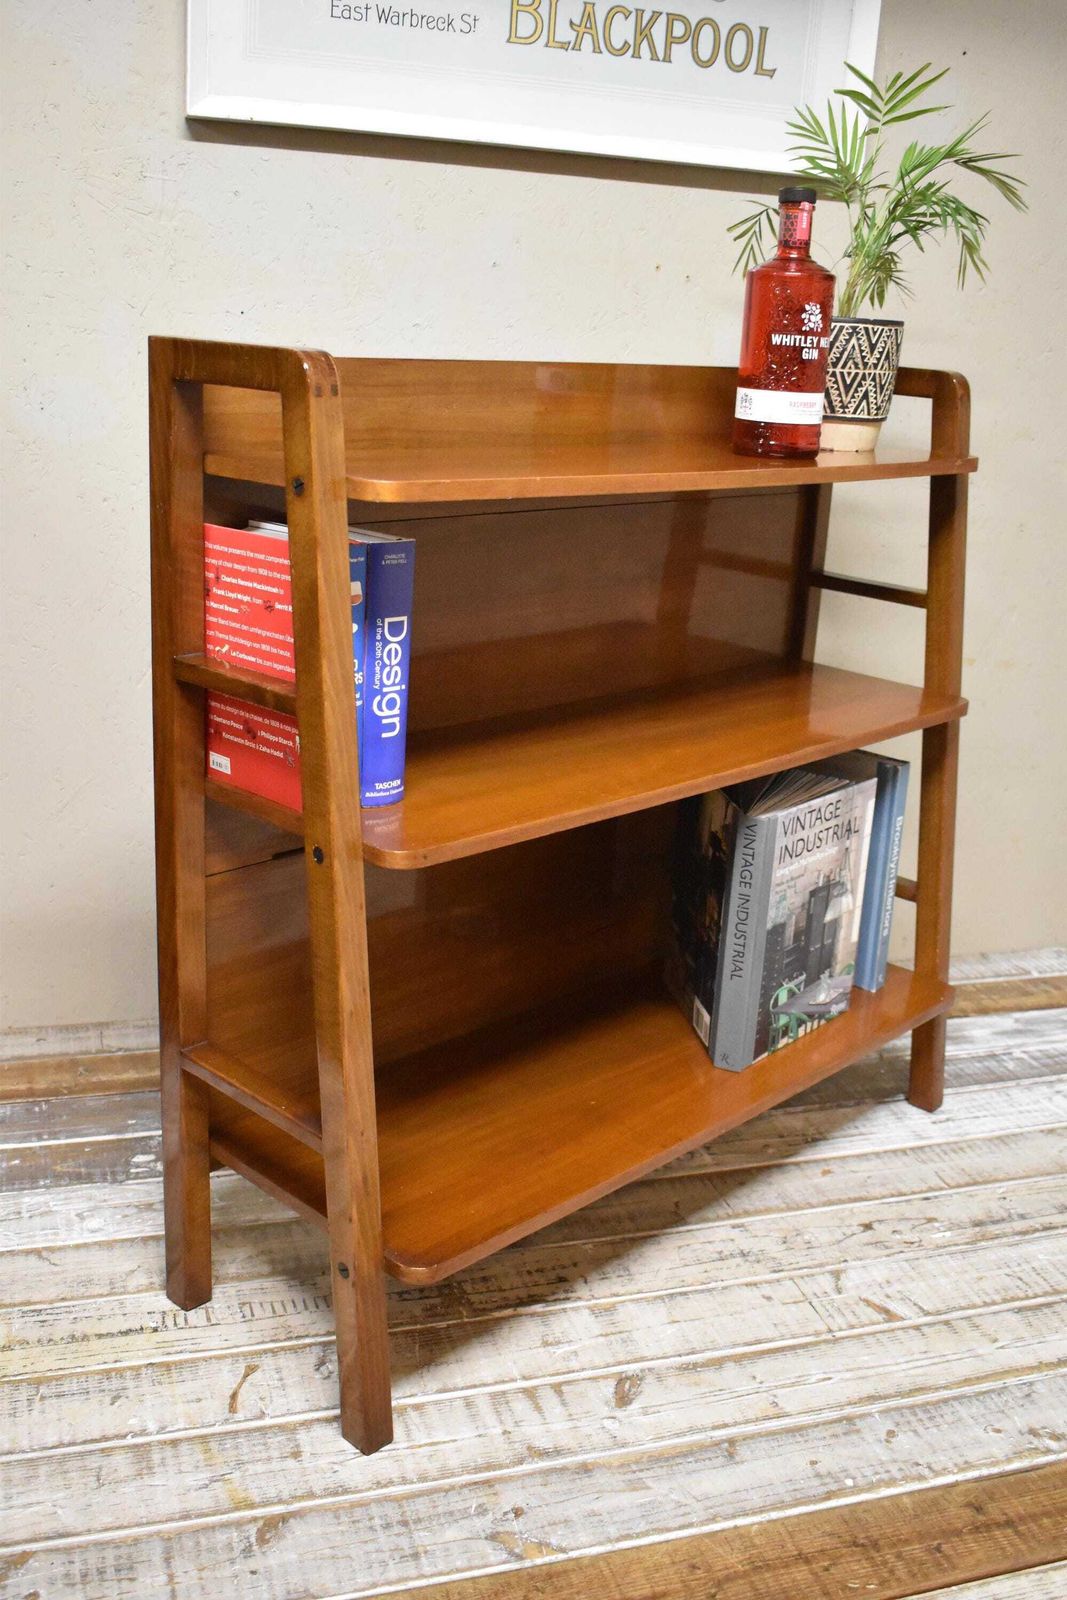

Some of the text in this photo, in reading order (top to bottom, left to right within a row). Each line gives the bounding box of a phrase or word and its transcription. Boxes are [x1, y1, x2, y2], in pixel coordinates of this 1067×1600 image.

[330, 0, 480, 35] East Warbreck St
[507, 0, 777, 79] BLACKPOOL
[771, 333, 818, 348] WHITLEY
[802, 348, 819, 361] GIN
[373, 618, 383, 690] of the 20th Century
[373, 616, 408, 738] Design
[374, 779, 401, 790] TASCHEN
[778, 817, 860, 865] INDUSTRIAL
[782, 799, 842, 838] VINTAGE
[882, 815, 903, 937] Brooklyn Interiors
[730, 824, 758, 981] VINTAGE INDUSTRIAL
